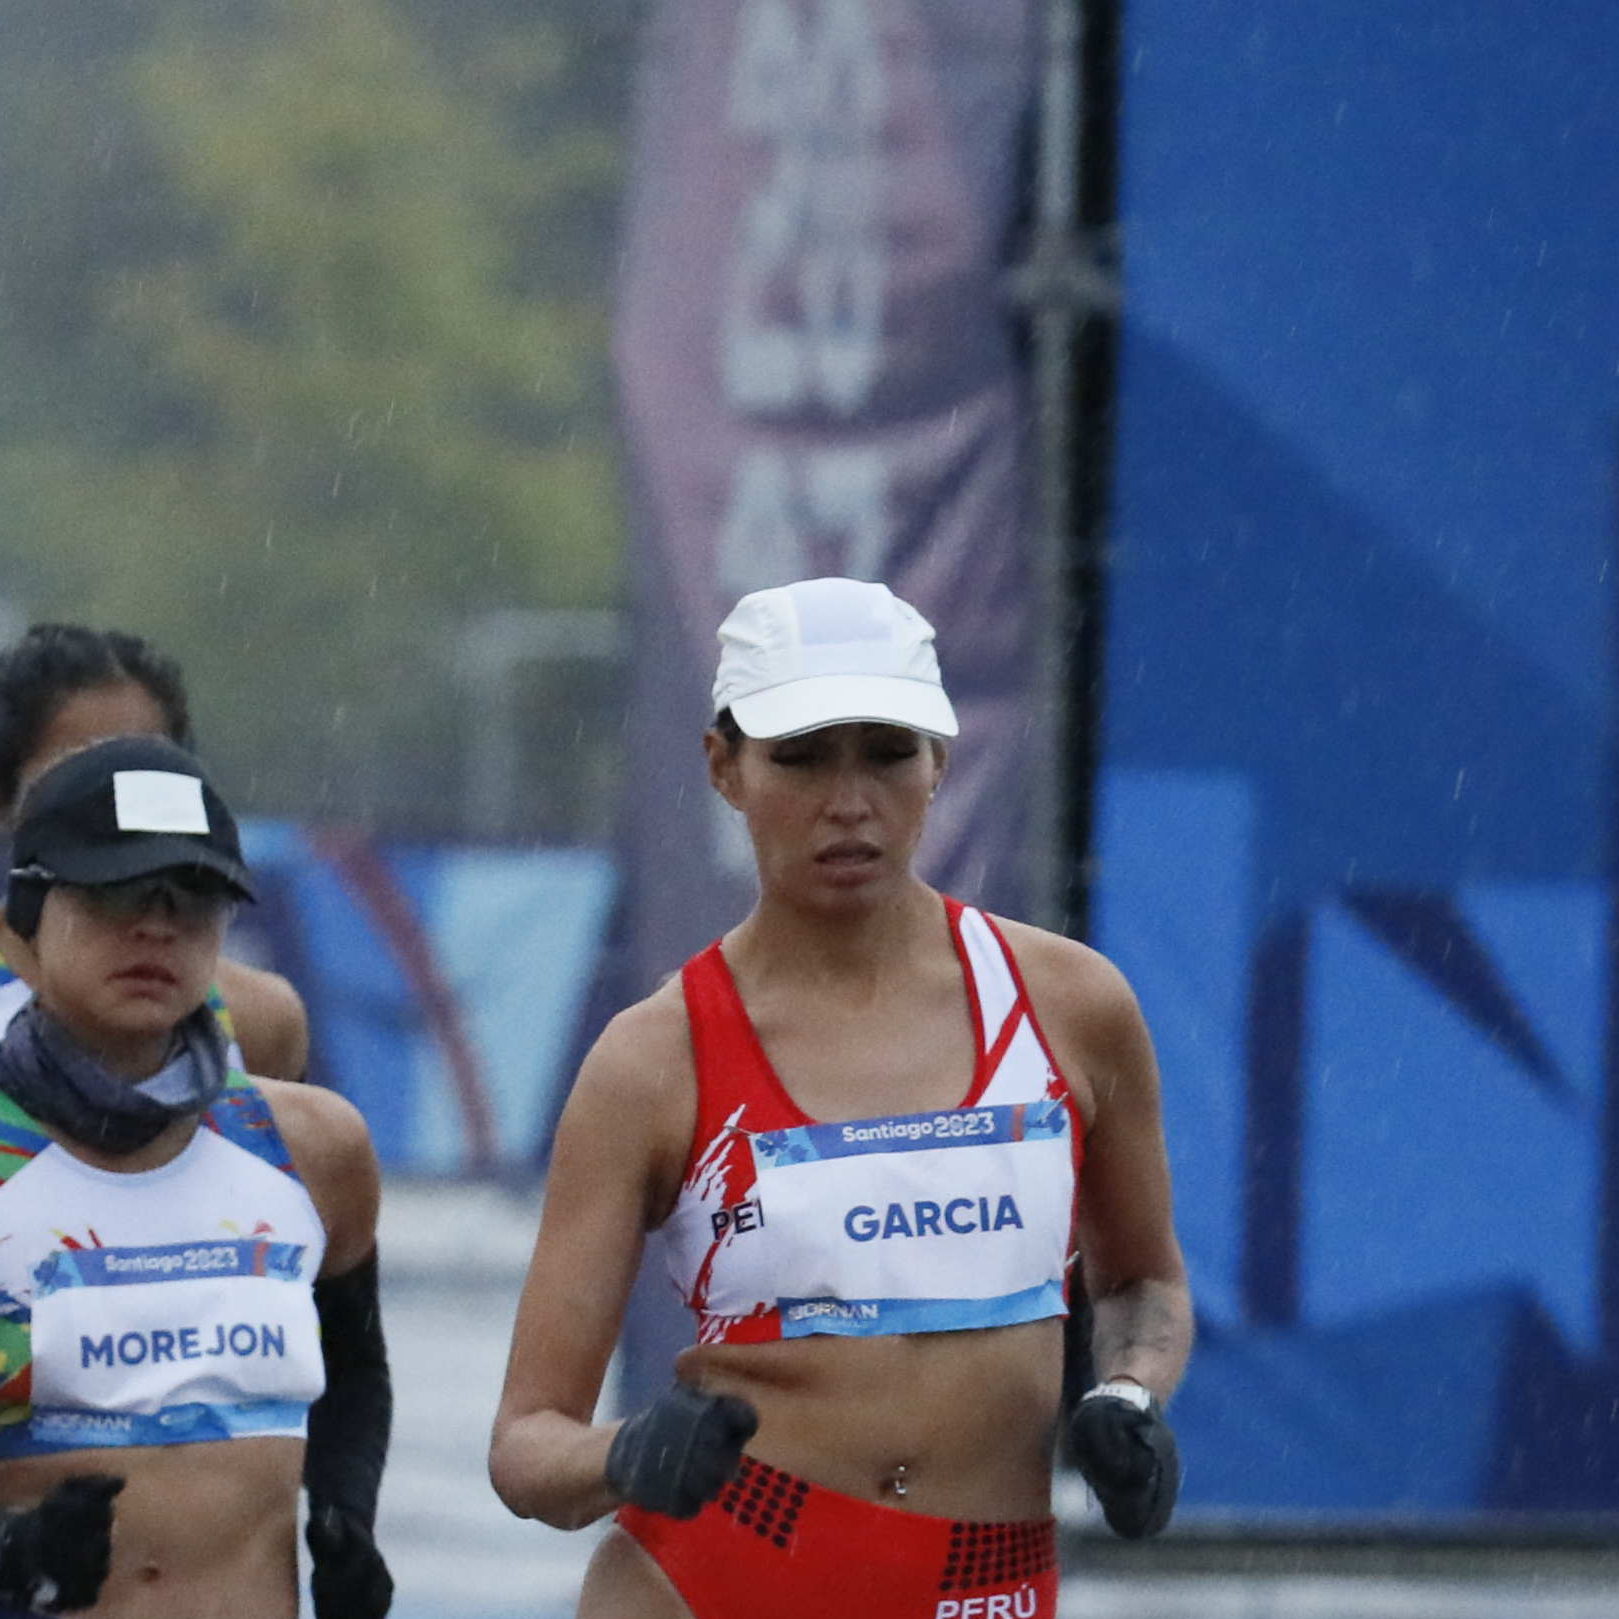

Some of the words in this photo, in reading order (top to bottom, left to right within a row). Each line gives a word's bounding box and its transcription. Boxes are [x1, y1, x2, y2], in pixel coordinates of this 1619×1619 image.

[711, 1198, 765, 1241] PE
[843, 1194, 1024, 1243] GARCIA
[78, 1322, 287, 1371] MOREJON
